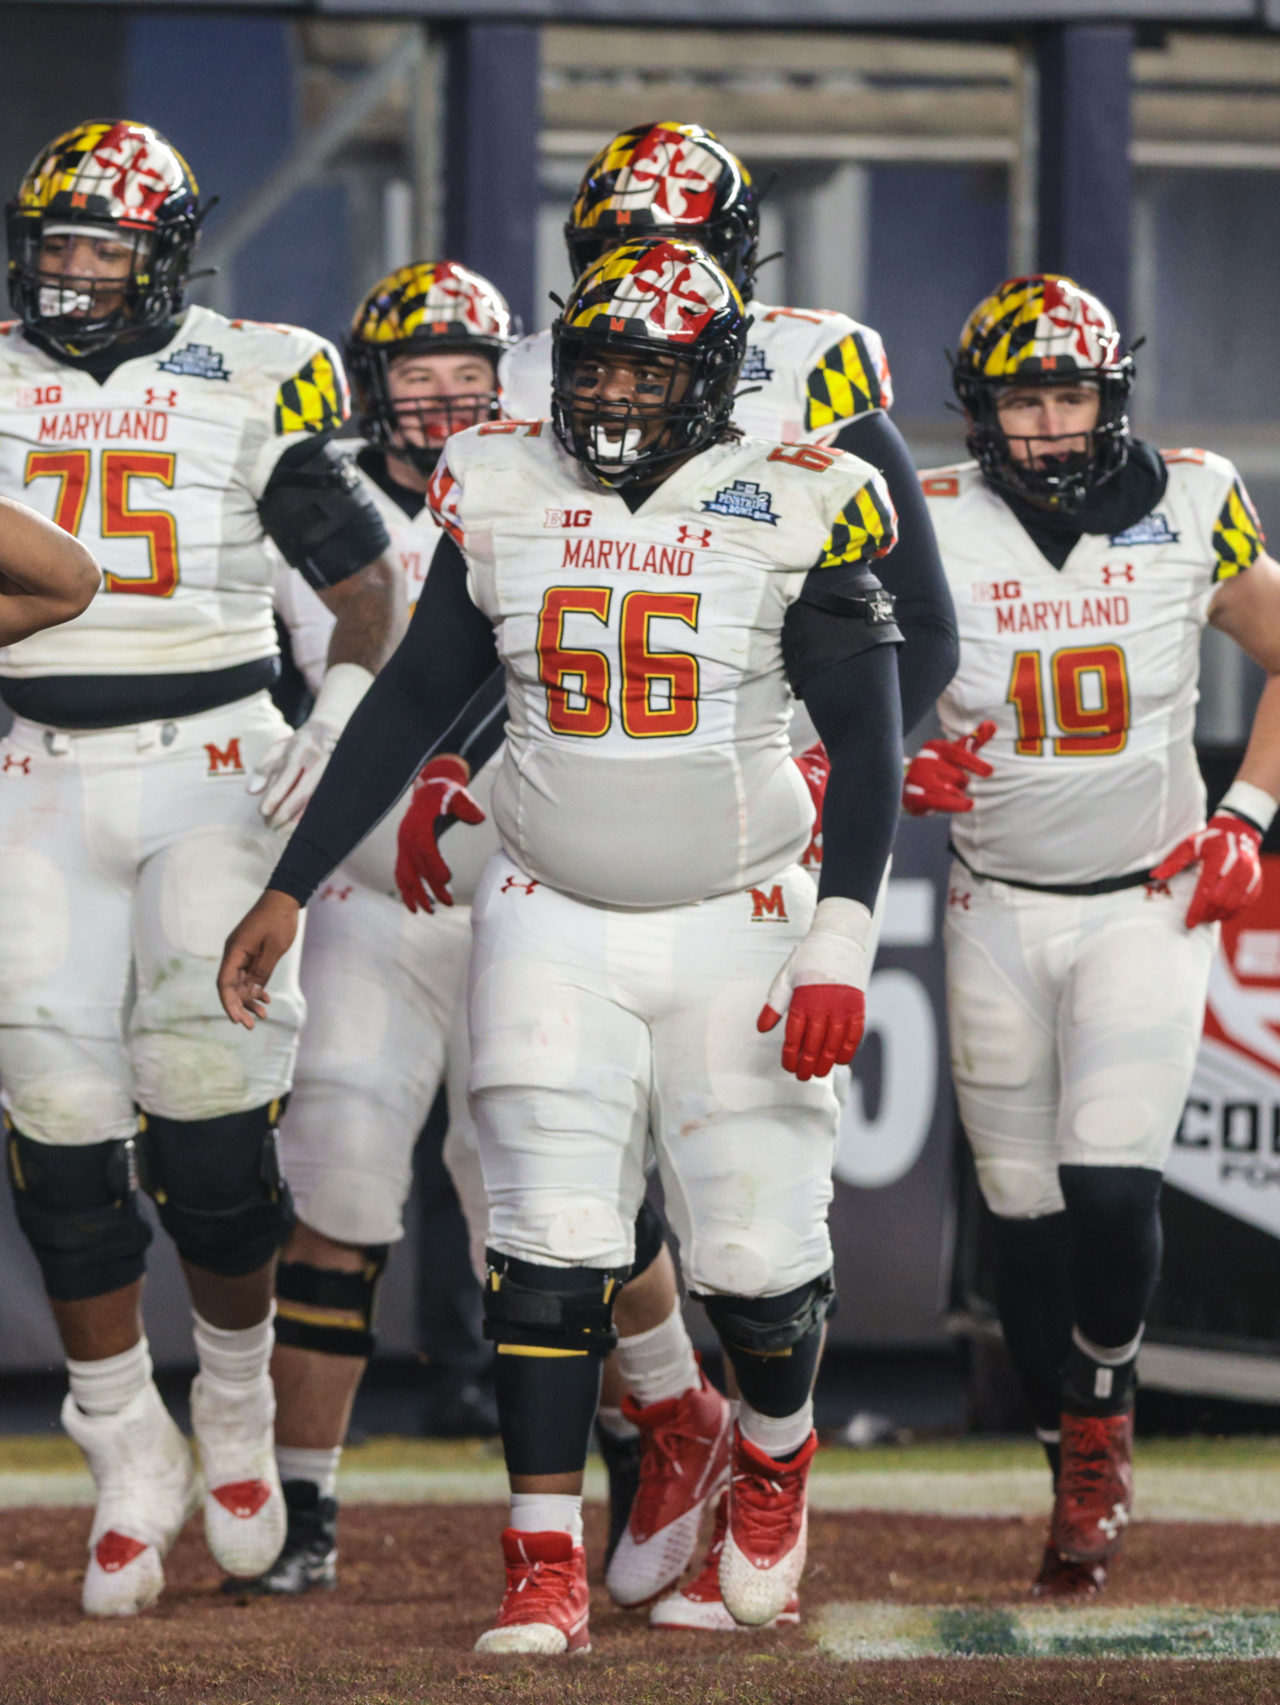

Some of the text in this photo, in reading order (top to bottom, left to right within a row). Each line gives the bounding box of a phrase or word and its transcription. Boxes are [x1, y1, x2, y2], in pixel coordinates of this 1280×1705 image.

[37, 411, 168, 442] MARYLAND
[24, 448, 179, 598] 75
[561, 539, 695, 577] MARYLAND
[996, 595, 1129, 634] MARYLAND
[536, 585, 702, 739] 66
[1006, 642, 1131, 757] 19
